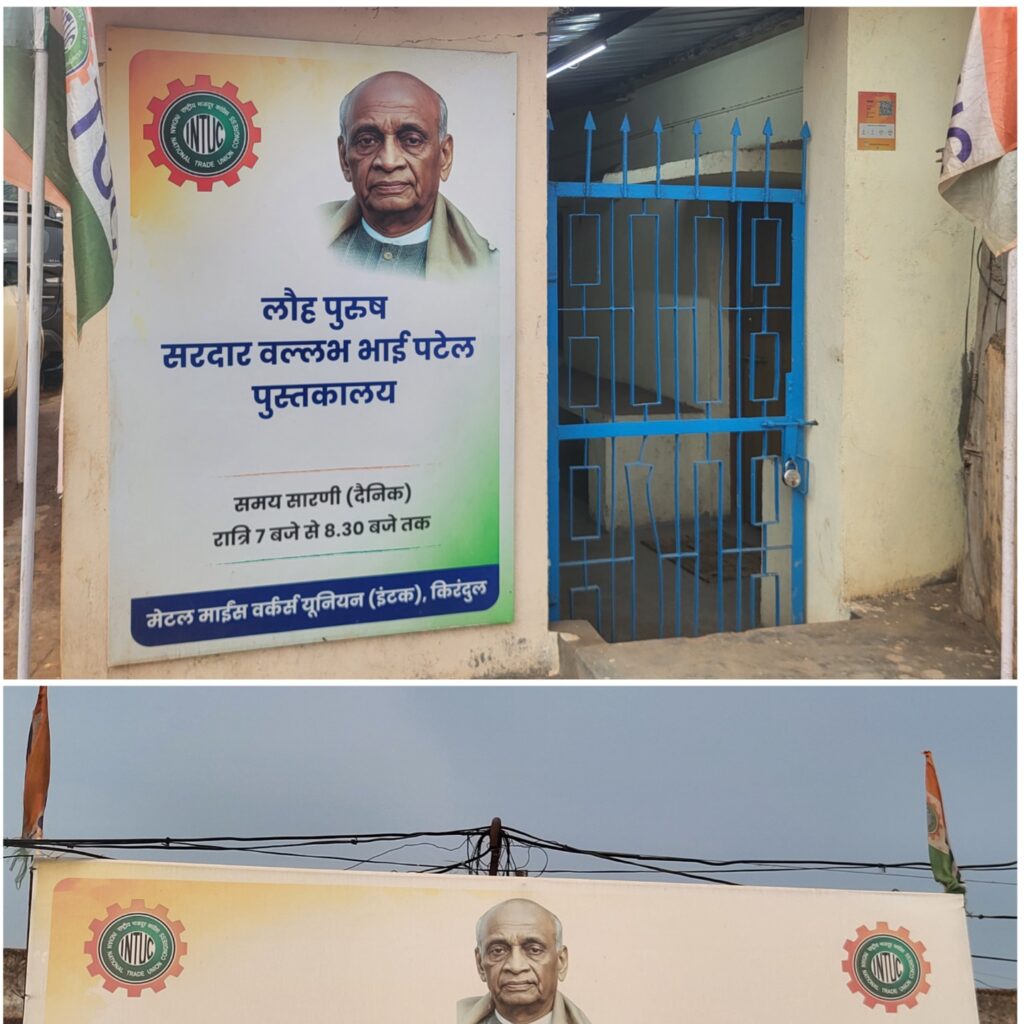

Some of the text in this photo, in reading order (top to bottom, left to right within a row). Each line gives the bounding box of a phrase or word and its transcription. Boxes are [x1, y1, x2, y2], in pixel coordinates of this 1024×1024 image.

[170, 114, 240, 168] INDIAN NATIONAL TRADE UNION CONGRESS
[186, 114, 223, 153] INTUC
[261, 288, 388, 330] लौह पुरुष
[161, 331, 475, 368] सरदार वल्लभ भाई पटेल
[252, 381, 397, 419] पुस्तकालय
[233, 482, 412, 512] समय सारणी (दैनिक)
[213, 514, 431, 547] रात्रि 7 बजे से 8.30 बजे तक
[146, 608, 195, 630] मेटल
[251, 594, 300, 618] वर्कर्स
[301, 594, 364, 619] यूनियन
[369, 585, 426, 610] (इंटक),
[430, 580, 487, 603] किरंदुल
[120, 932, 154, 965] INTUC
[872, 952, 902, 982] INTUC
